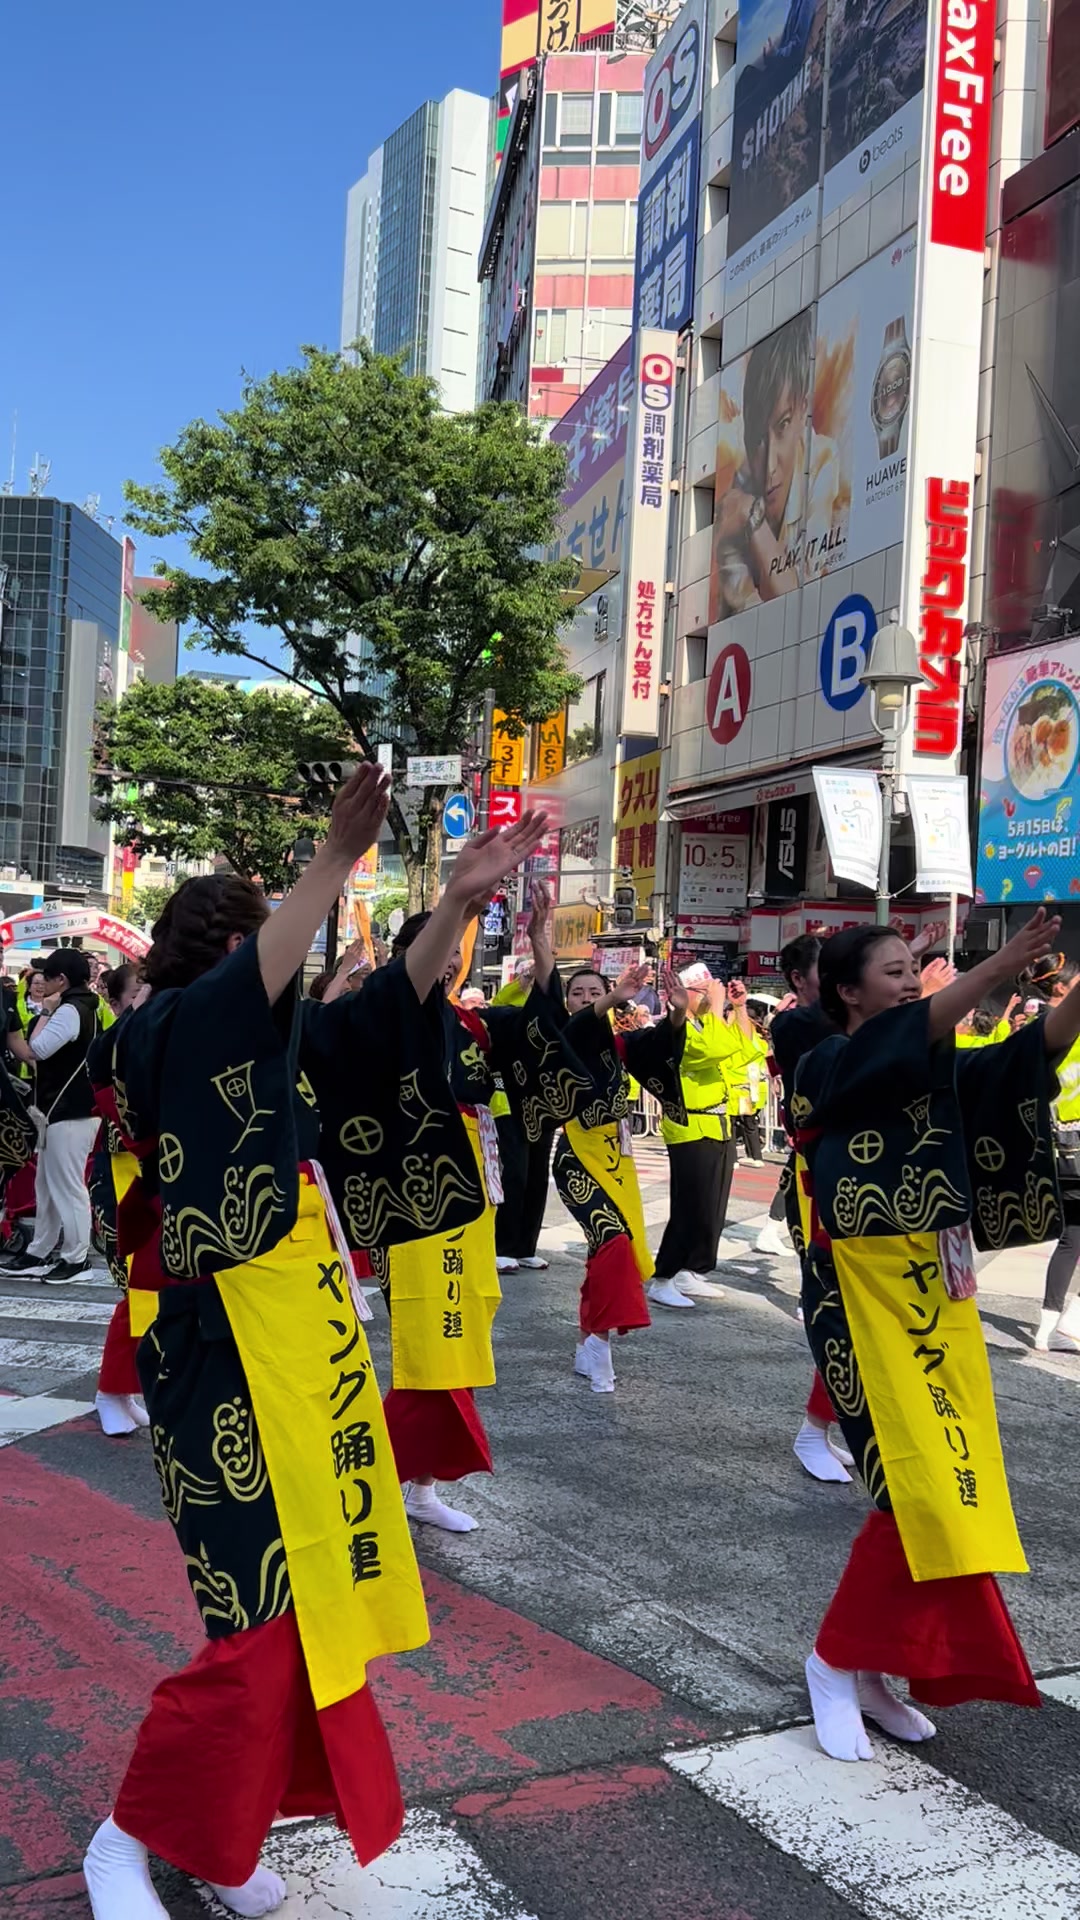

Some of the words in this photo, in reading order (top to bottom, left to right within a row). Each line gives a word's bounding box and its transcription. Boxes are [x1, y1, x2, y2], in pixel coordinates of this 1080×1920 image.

[646, 26, 697, 146] OS
[938, 0, 985, 197] axFree
[872, 125, 904, 162] beats
[640, 140, 692, 272] 調剤
[639, 233, 687, 329] 薬局
[644, 357, 673, 410] OS
[640, 412, 667, 509] 調剤薬局
[865, 457, 907, 491] HUAWE
[805, 537, 819, 562] IT
[632, 579, 656, 699] 処方せん受付
[912, 476, 970, 755] ビックカメラ
[830, 610, 867, 697] B
[712, 655, 742, 729] A
[620, 766, 660, 819] クスリ
[684, 843, 706, 868] 10
[778, 807, 797, 880] ASUS
[998, 838, 1077, 861] ヨーグルトの日!
[45, 903, 58, 912] 24
[902, 1259, 978, 1508] ヤング踊り連
